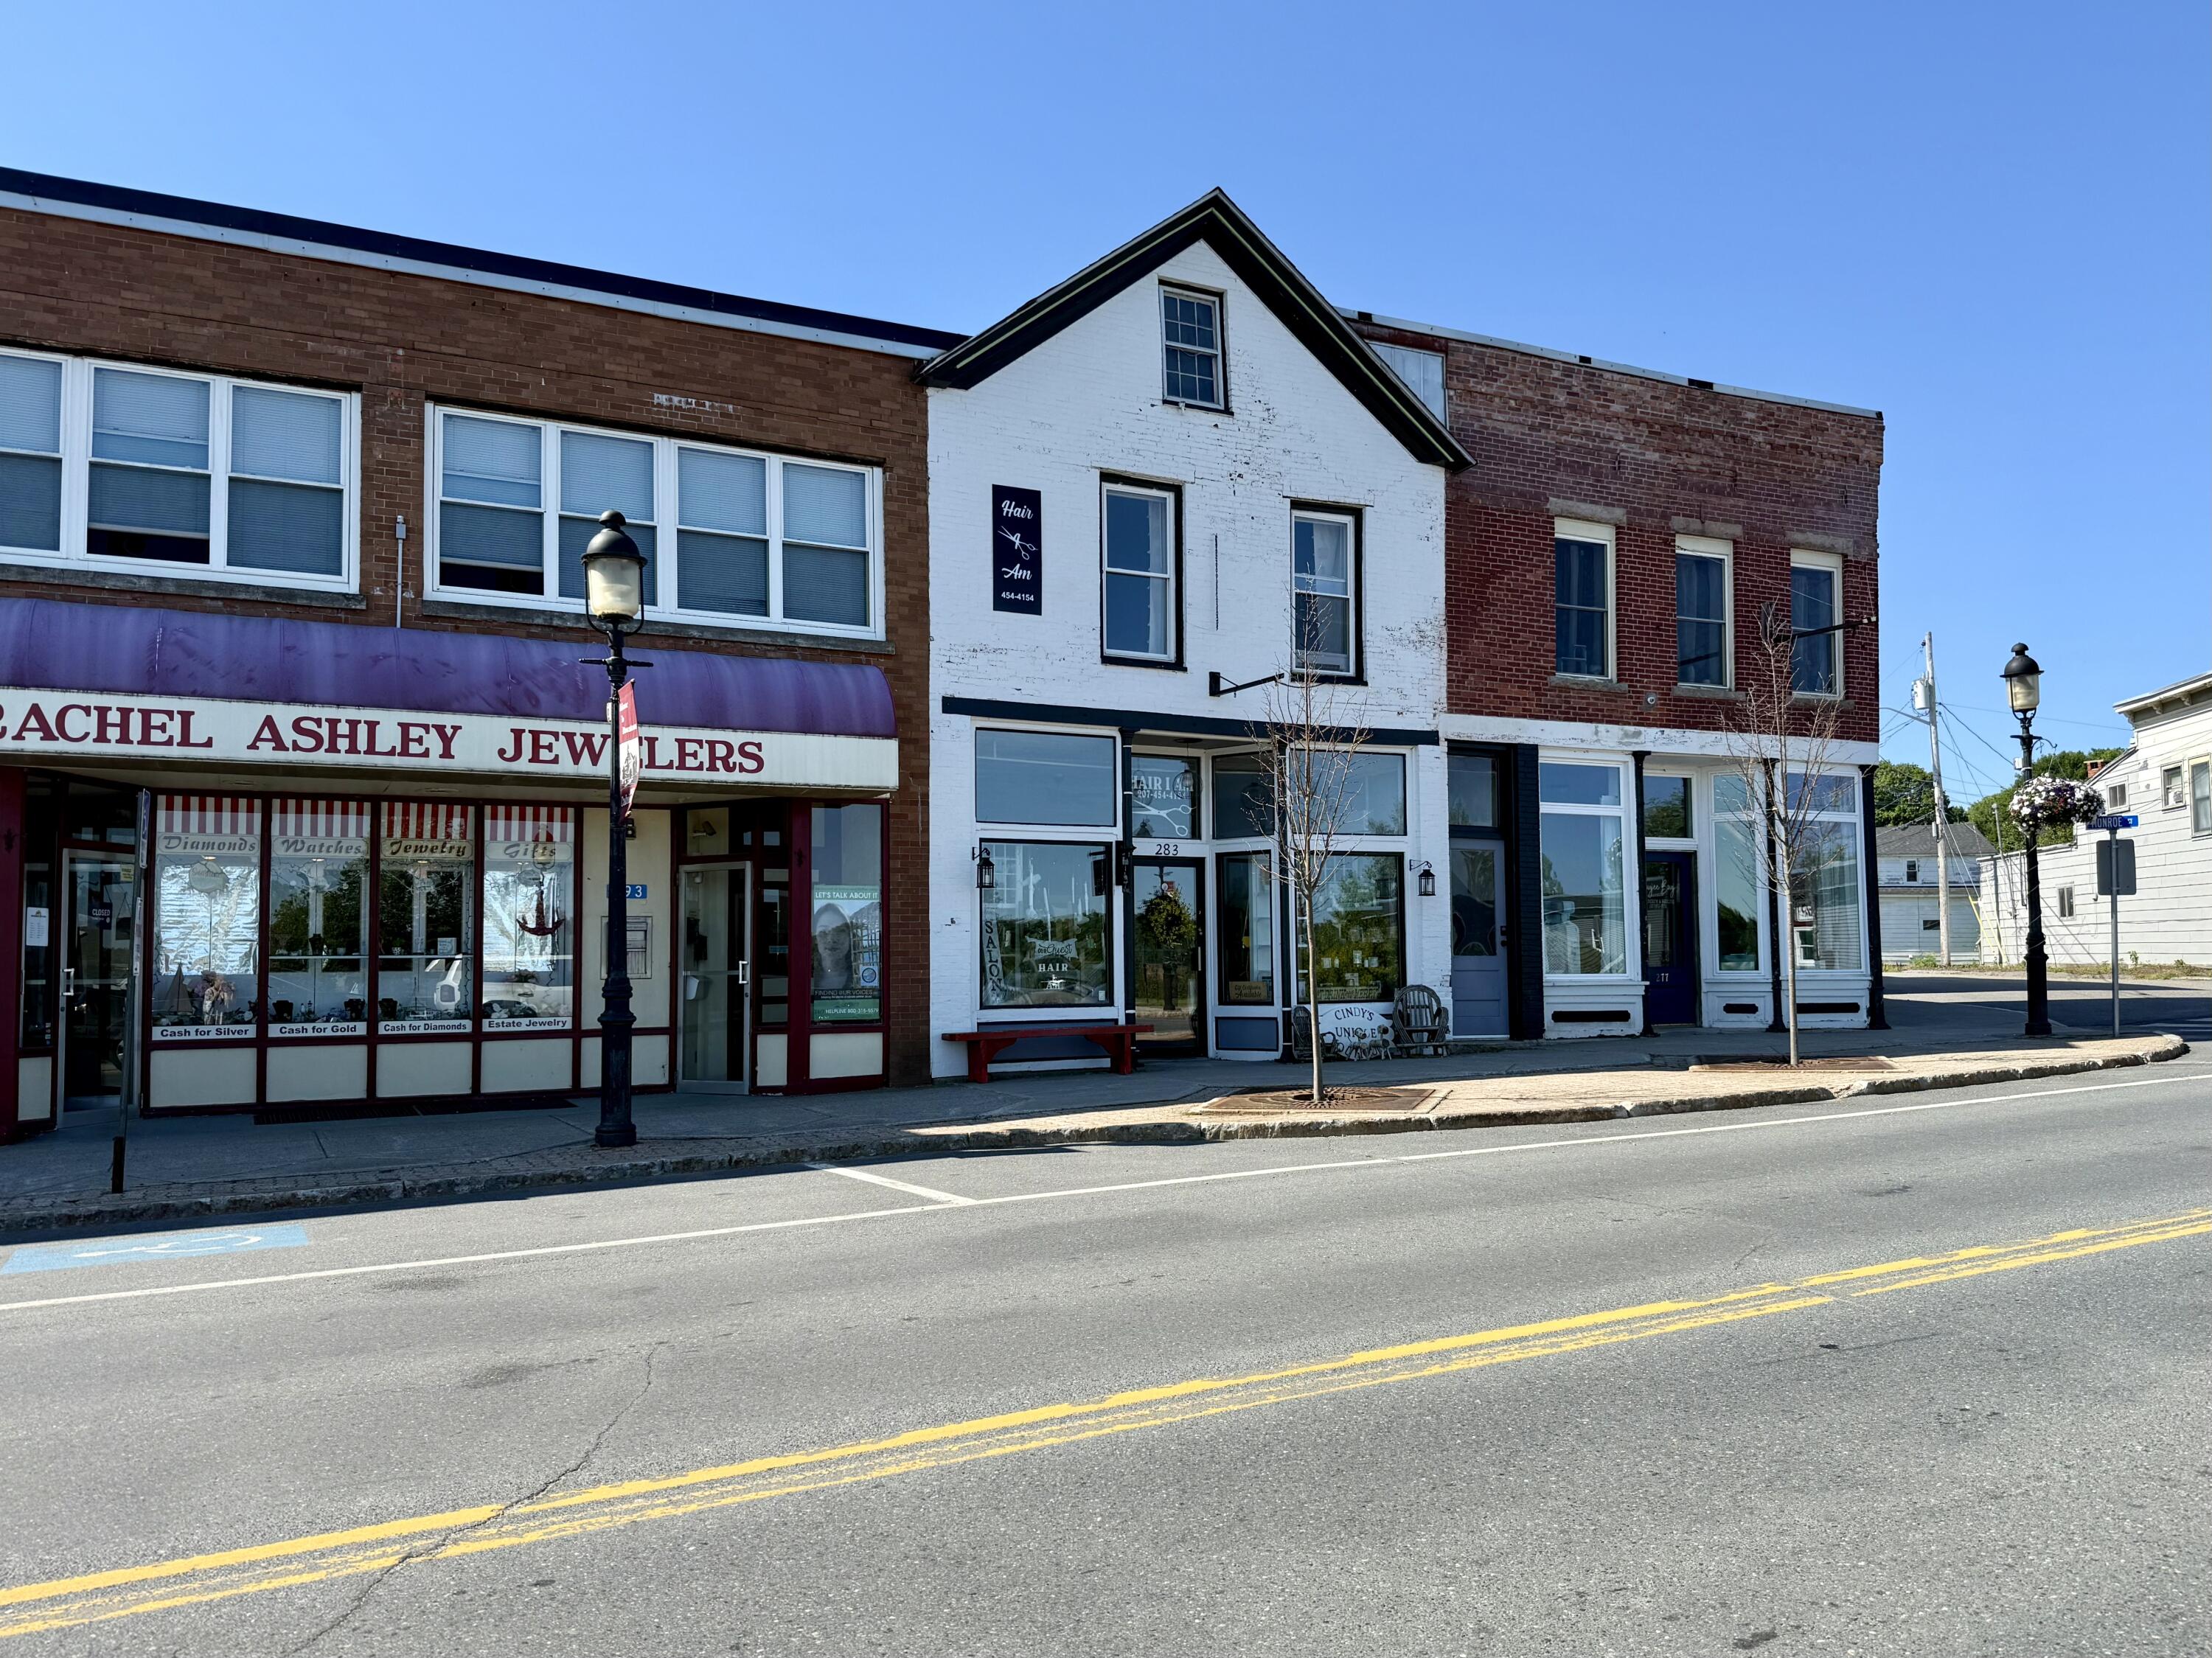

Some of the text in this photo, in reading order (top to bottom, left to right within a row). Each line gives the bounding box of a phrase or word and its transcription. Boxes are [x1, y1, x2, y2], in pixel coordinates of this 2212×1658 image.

[1002, 500, 1033, 519] Hair
[1001, 563, 1032, 580] Am
[1001, 591, 1034, 602] 454-4154
[0, 703, 765, 774] ACHEL ASHLEY JEWLERS
[1166, 777, 1170, 790] I
[2091, 816, 2123, 828] MONROE
[162, 835, 257, 851] Diamonds
[281, 839, 362, 854] Watches
[389, 840, 466, 857] Jewelry
[1155, 843, 1179, 856] 283
[504, 843, 556, 858] Gifts
[625, 885, 642, 898] 93
[92, 908, 111, 916] CLOSED
[985, 921, 1004, 992] SALON
[1038, 963, 1068, 972] HAIR
[1335, 1006, 1374, 1021] CINDY'S
[279, 1024, 357, 1034] Cash for Gold
[383, 1023, 467, 1032] Cash for Diamonds
[487, 1018, 567, 1028] Estate Jewelry
[160, 1027, 249, 1037] Cash for Silver
